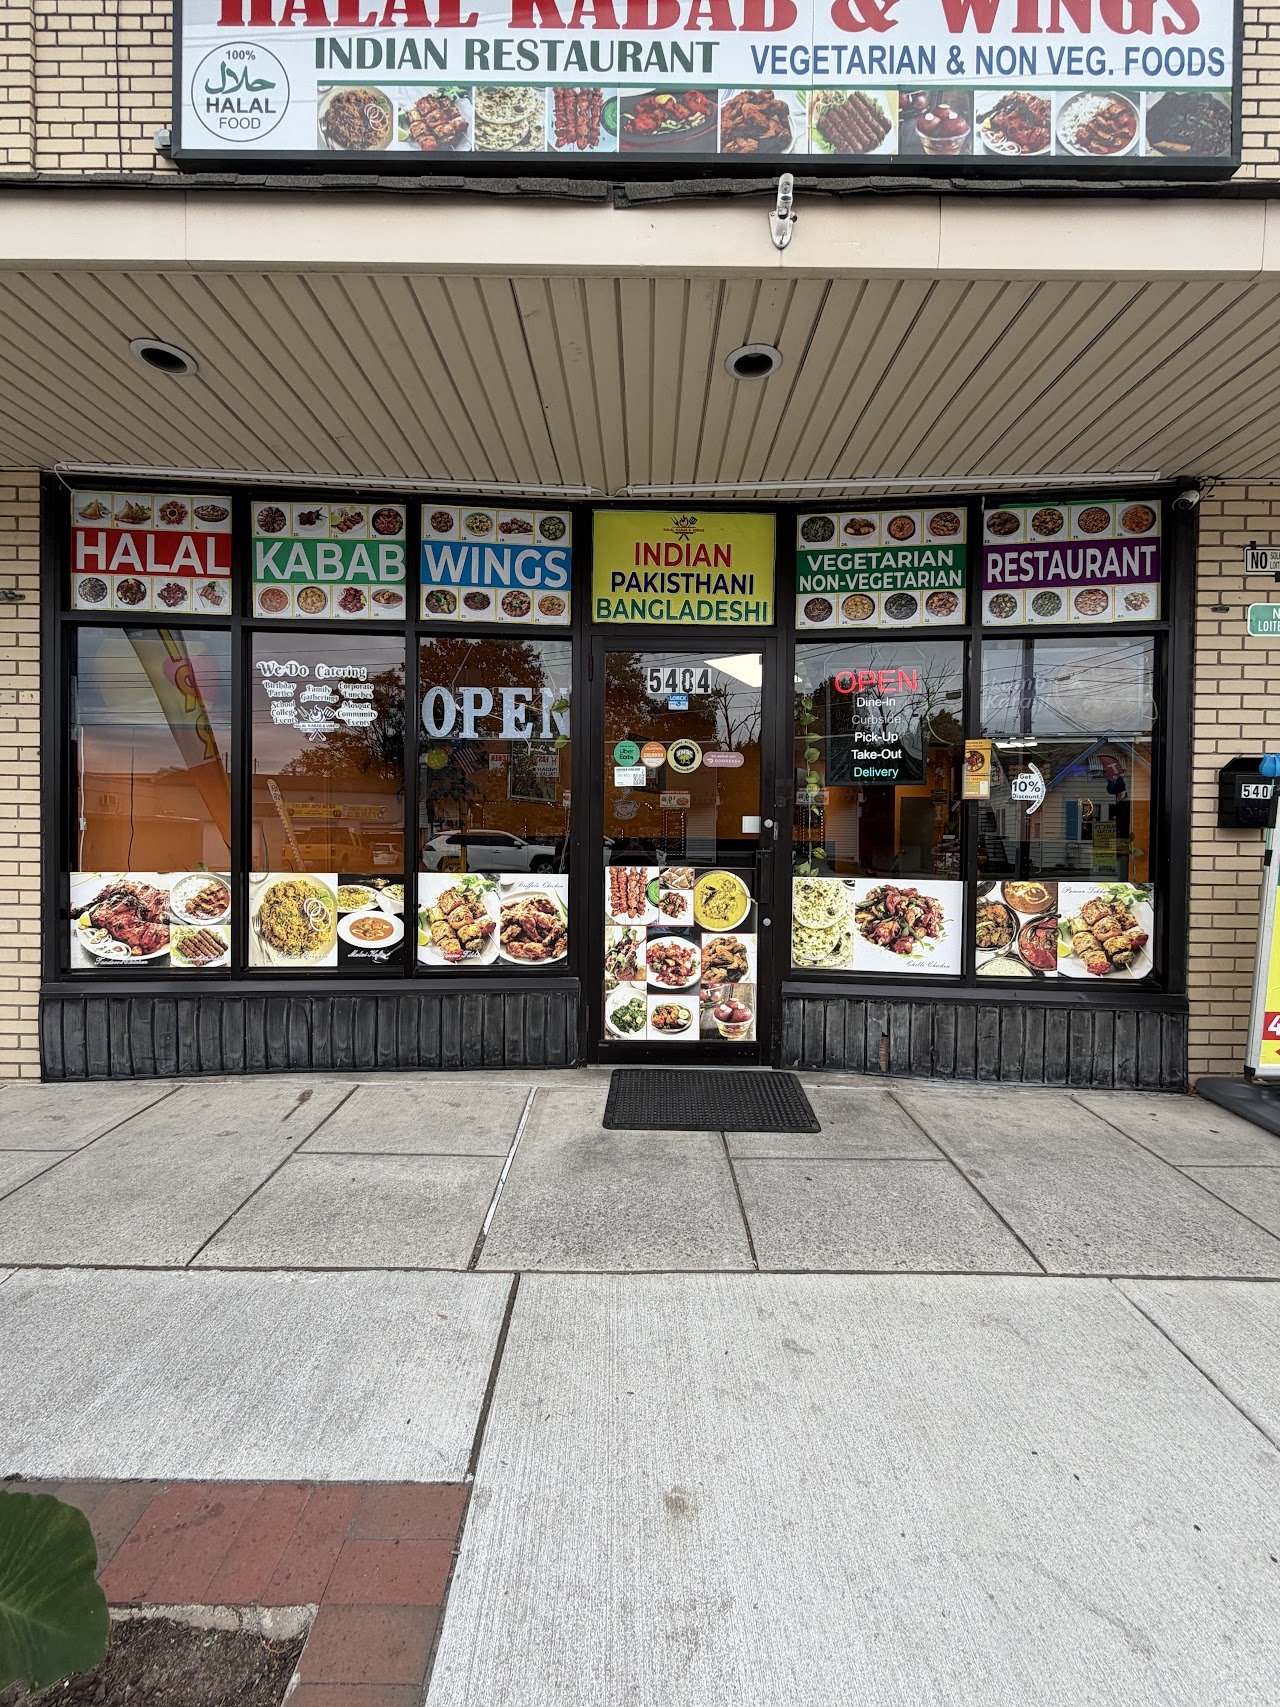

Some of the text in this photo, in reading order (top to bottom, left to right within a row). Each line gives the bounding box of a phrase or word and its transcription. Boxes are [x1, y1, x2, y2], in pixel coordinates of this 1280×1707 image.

[226, 50, 256, 60] 100%
[315, 37, 720, 73] INDIAN RESTAURANT
[750, 44, 1225, 77] VEGETARIAN & NON VEG. FOODS
[204, 60, 276, 95] حلال
[206, 97, 277, 113] HALAL
[219, 117, 261, 129] FOOD
[76, 531, 231, 576] HALAL
[633, 541, 732, 568] INDIAN
[256, 541, 406, 583] KABAB
[424, 544, 568, 588] WINGS
[807, 549, 954, 572] VEGETARIAN
[988, 545, 1157, 584] RESTAURANT
[1251, 551, 1268, 569] NO
[611, 571, 755, 596] PAKISTHANI
[799, 570, 962, 592] NON-VEGETARIAN
[596, 597, 768, 623] BANGLADESHI
[258, 662, 367, 680] We Do Catering
[264, 681, 296, 691] Birthday
[649, 668, 711, 693] 5404
[834, 668, 918, 694] OPEN
[268, 689, 294, 697] Parties
[306, 685, 332, 694] Family
[339, 682, 374, 692] Corporate
[300, 693, 339, 703] Gatherings
[343, 690, 374, 699] Lunches
[271, 700, 296, 709] School
[343, 701, 371, 710] Mosque
[856, 697, 896, 708] Dine-In
[271, 708, 298, 717] College
[337, 710, 378, 719] Community
[421, 686, 571, 739] OPEN
[274, 717, 299, 725] Events
[346, 719, 371, 727] Events
[851, 714, 902, 725] Curbside
[854, 732, 899, 744] Pick-Up
[851, 749, 902, 760] Take-Out
[853, 767, 899, 779] Delivery
[1012, 781, 1041, 793] 10%
